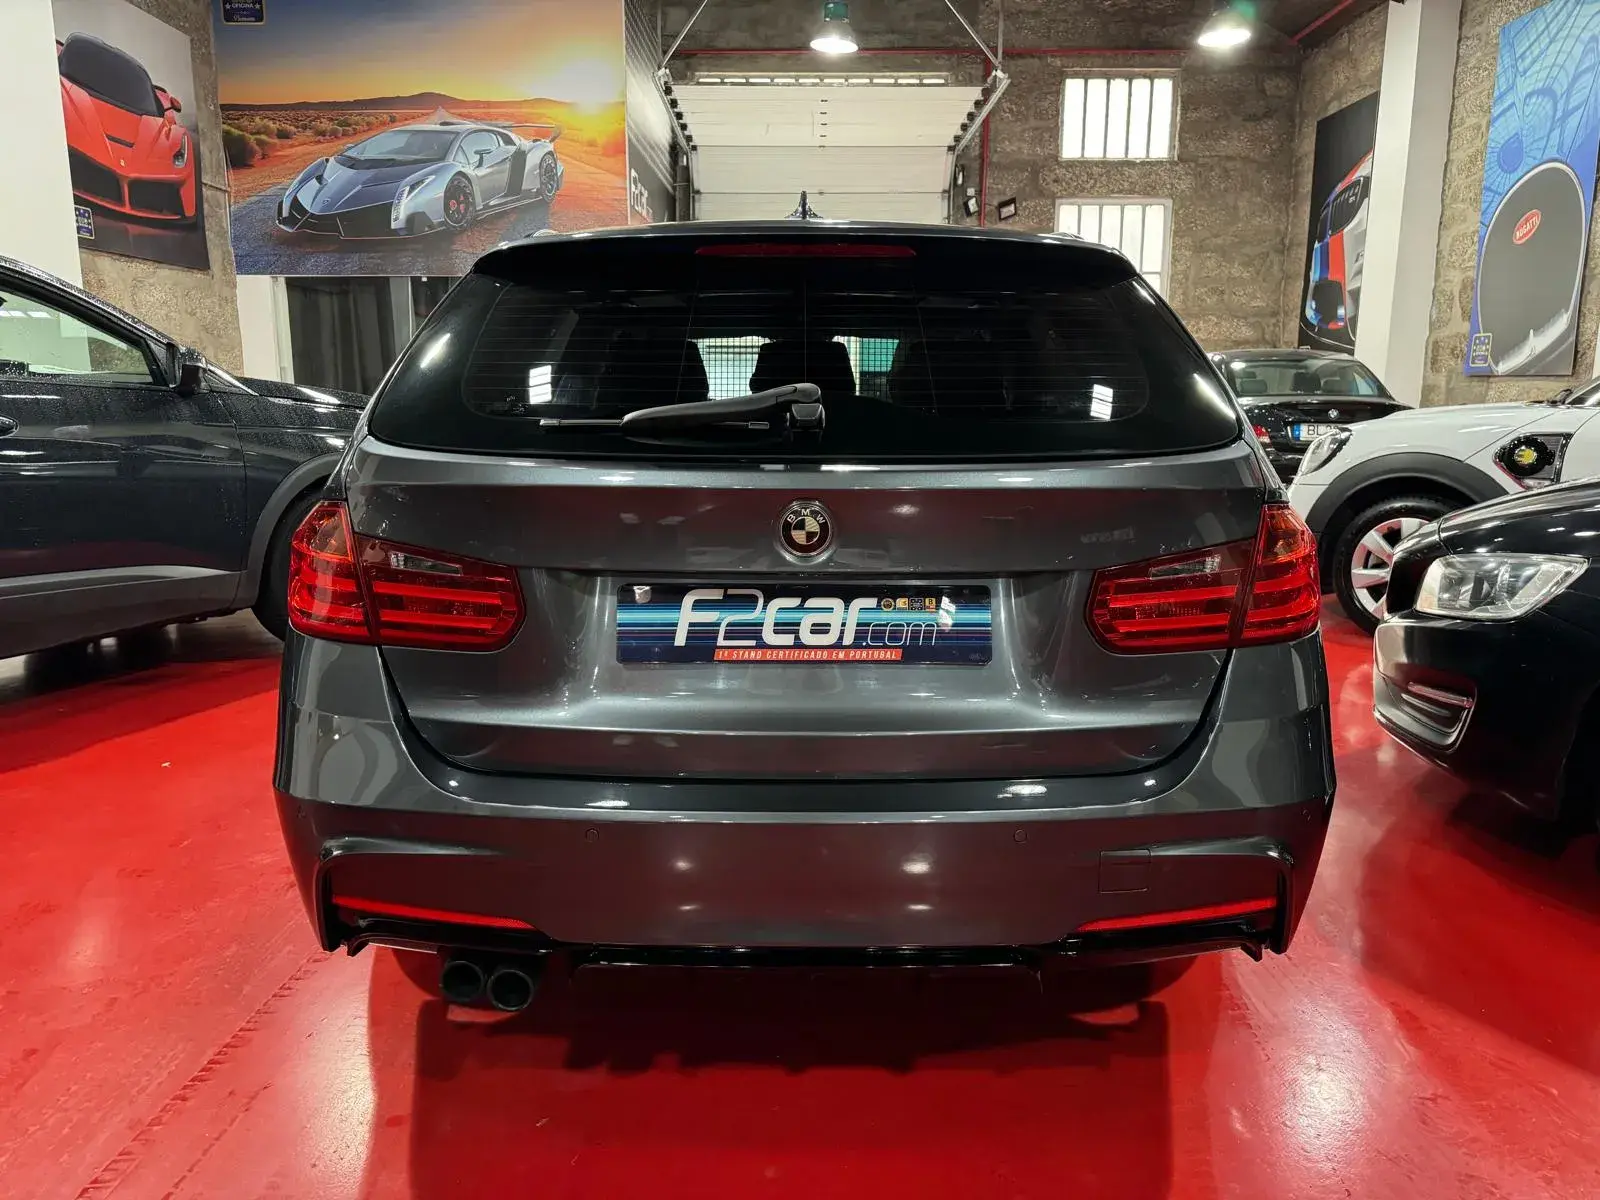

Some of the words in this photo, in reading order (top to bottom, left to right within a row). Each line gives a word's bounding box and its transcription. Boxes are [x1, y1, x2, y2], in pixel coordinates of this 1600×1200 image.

[786, 508, 826, 524] BMW
[732, 651, 762, 659] STAND
[766, 651, 828, 659] CERTIFICADO
[832, 651, 845, 659] EM
[849, 651, 897, 659] PORTUGAL
